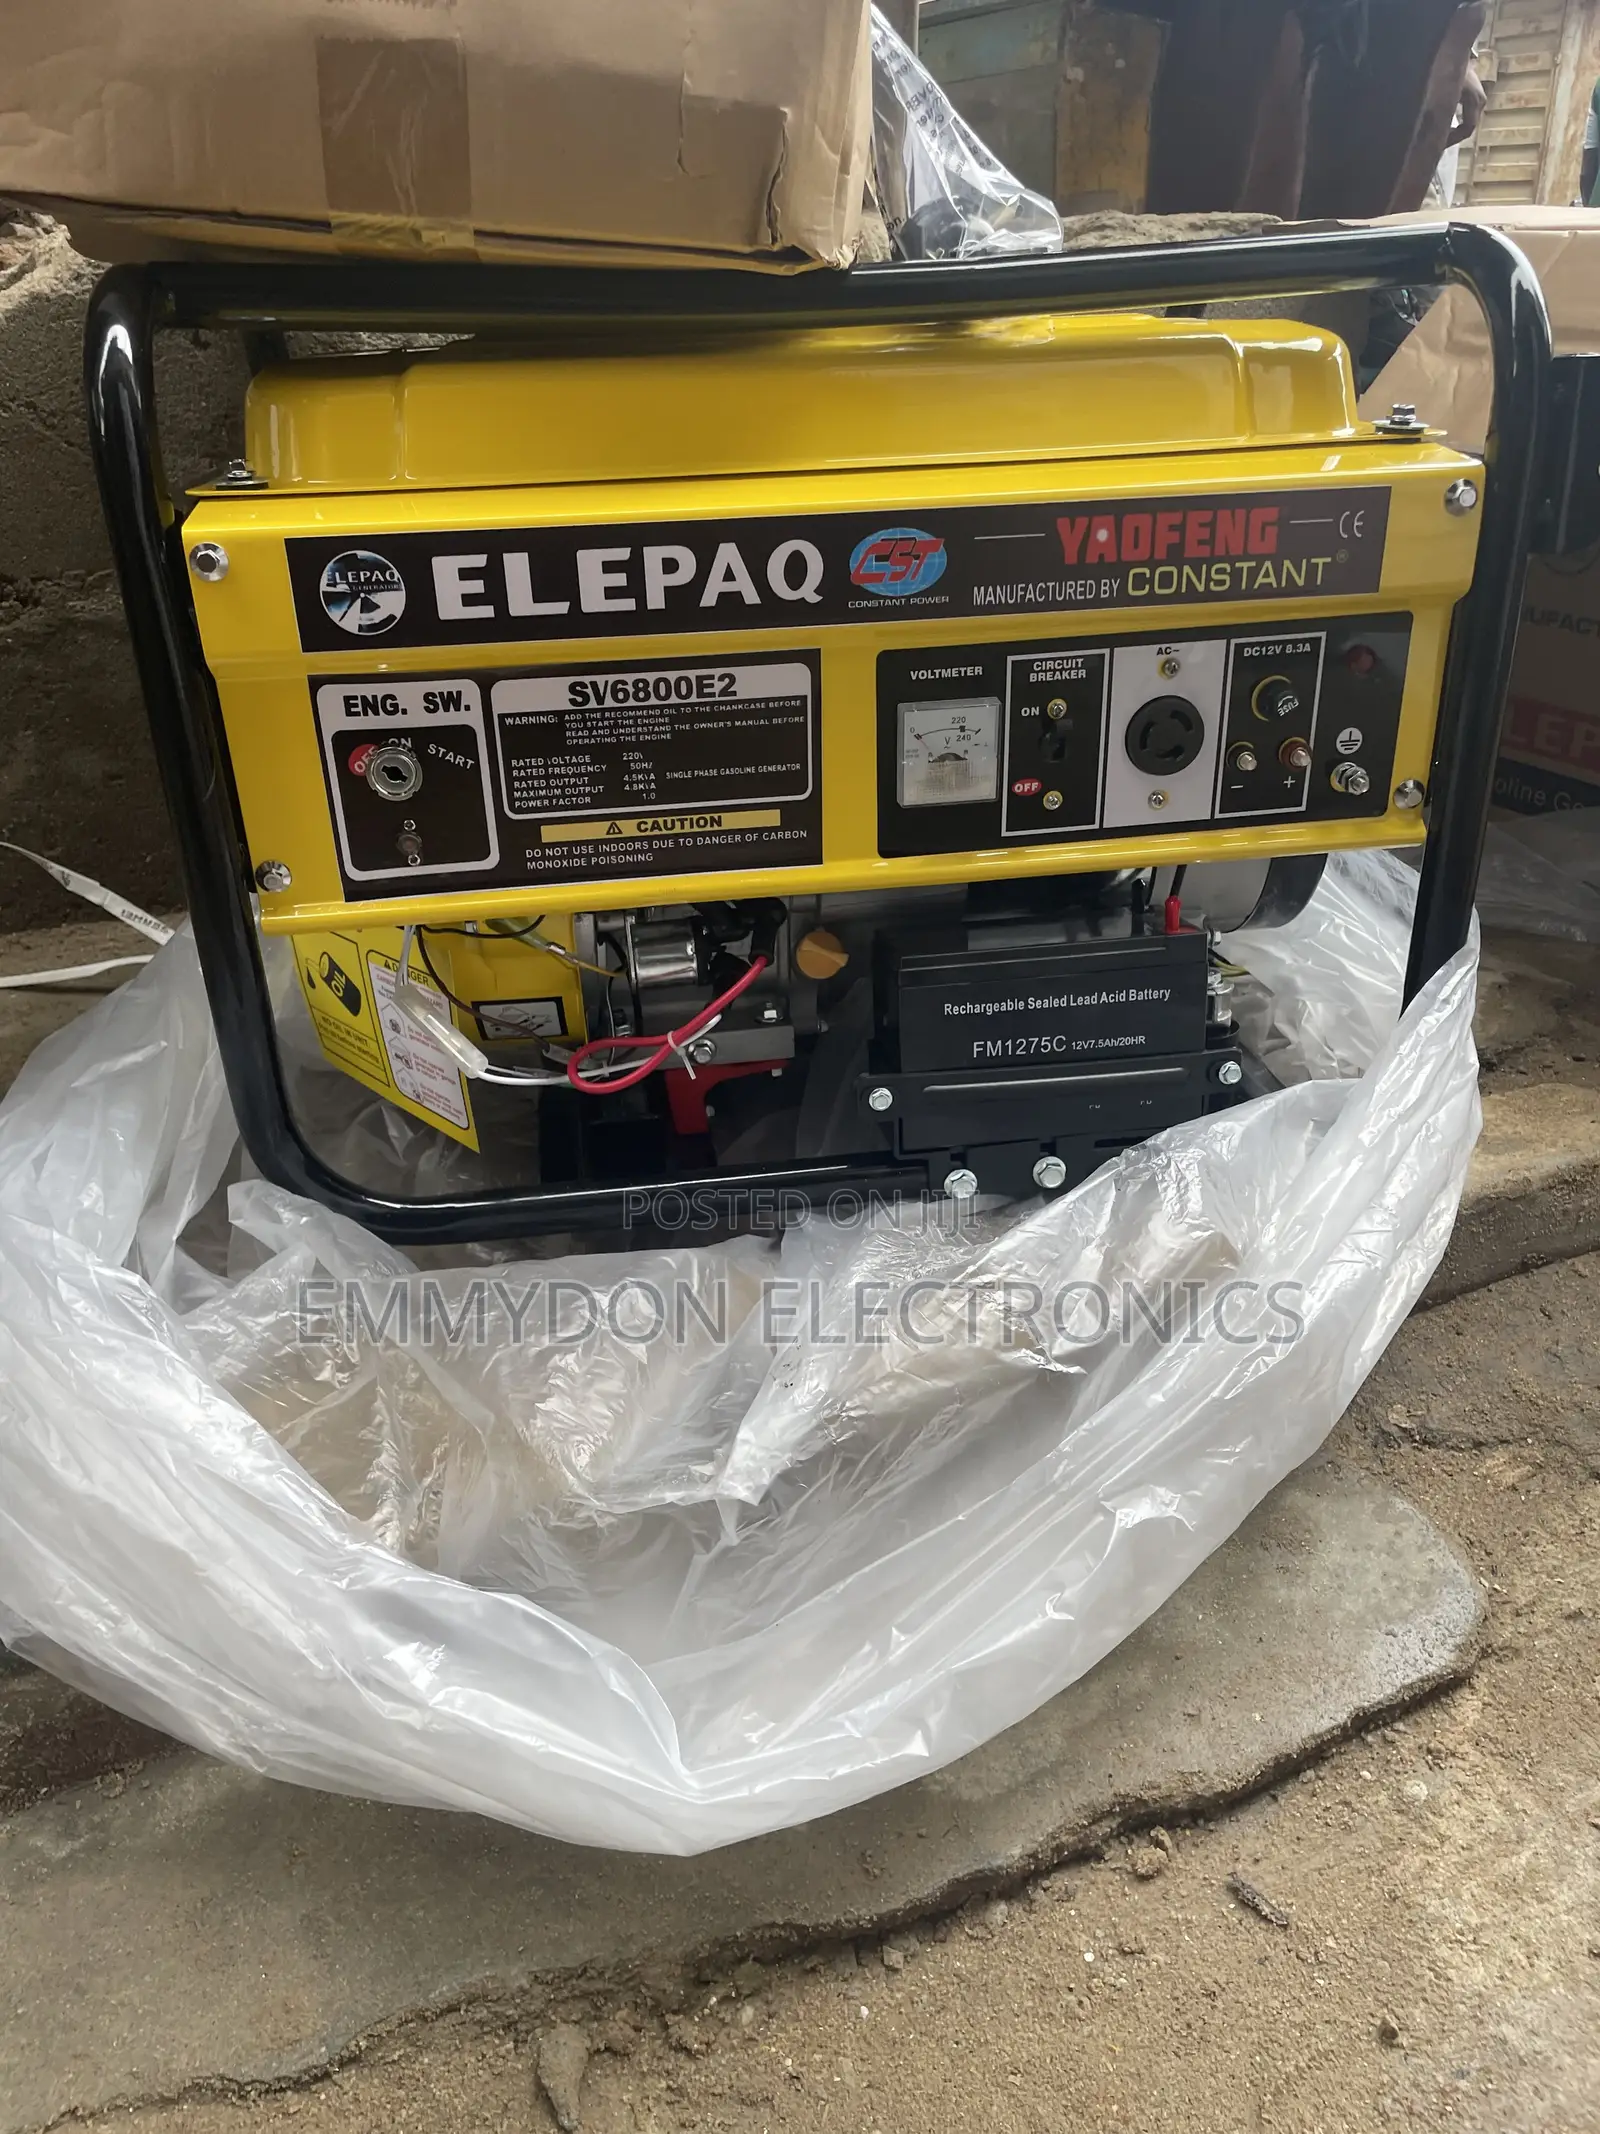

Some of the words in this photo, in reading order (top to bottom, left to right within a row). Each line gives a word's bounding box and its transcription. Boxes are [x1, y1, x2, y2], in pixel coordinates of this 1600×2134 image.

[1339, 510, 1365, 538] CE
[1056, 506, 1280, 565] YAOFENG
[850, 538, 945, 585] CST
[326, 569, 400, 584] ELEPAQ
[432, 539, 824, 620] ELEPAQ
[973, 579, 1096, 606] MANUFACTURED
[1100, 578, 1120, 599] BY
[1127, 556, 1332, 597] CONSTANT
[848, 598, 905, 609] CONSTANT
[910, 595, 949, 605] POWER
[1243, 645, 1282, 657] DC12V
[910, 666, 983, 680] VOLTMETER
[1033, 658, 1084, 671] CIRCUIT
[1029, 669, 1086, 682] BREAKER
[568, 672, 737, 707] SV6800E2
[343, 694, 408, 717] ENG.
[423, 690, 471, 714] SW.
[1021, 706, 1039, 717] ON
[1277, 697, 1299, 717] FUSE
[504, 714, 558, 726] WARNING:
[605, 709, 660, 718] RECOMMEND
[769, 700, 801, 708] BEFORE
[637, 717, 670, 725] ENGINE
[951, 716, 966, 724] 220
[566, 729, 589, 737] READ
[613, 725, 672, 734] UNDERSTAND
[694, 720, 732, 729] OWNER'S
[735, 719, 769, 727] MANUAL
[772, 716, 805, 724] BEFORE
[388, 737, 412, 748] ON
[566, 736, 617, 745] OPERATING
[640, 733, 672, 741] ENGINE
[956, 734, 971, 742] 240
[427, 743, 475, 770] START
[511, 757, 544, 767] RATED
[512, 767, 546, 777] RATED
[548, 764, 607, 775] FREQUENCY
[665, 771, 692, 780] SINGLE
[694, 769, 718, 777] PHASE
[720, 765, 756, 776] GASOLINE
[758, 763, 801, 773] GENERATOR
[513, 779, 546, 789] RATED
[549, 777, 589, 787] OUTPUT
[1014, 782, 1039, 792] OFF
[513, 789, 562, 799] MAXIMUM
[565, 785, 605, 795] OUTPUT
[515, 799, 550, 809] POWER
[552, 796, 592, 806] FACTOR
[636, 815, 722, 833] CAUTION
[525, 849, 542, 858] DO
[545, 846, 569, 856] NOT
[573, 845, 594, 855] USE
[598, 841, 649, 853] INDOORS
[652, 839, 675, 849] DUE
[678, 837, 693, 847] TO
[696, 834, 742, 845] DANGER
[745, 832, 759, 842] OF
[762, 830, 808, 841] CARBON
[527, 857, 587, 870] MONOXIDE
[591, 853, 654, 865] POISONING
[392, 962, 429, 987] DGER
[331, 970, 346, 997] OIL
[944, 998, 1025, 1015] Rechargeable
[1027, 994, 1067, 1010] Sealed
[1070, 992, 1098, 1006] Lead
[1099, 989, 1126, 1004] Acid
[1129, 988, 1171, 1002] Battery
[973, 1035, 1066, 1058] FM1275C
[1071, 1035, 1146, 1051] 12V7.5Ah/20HR
